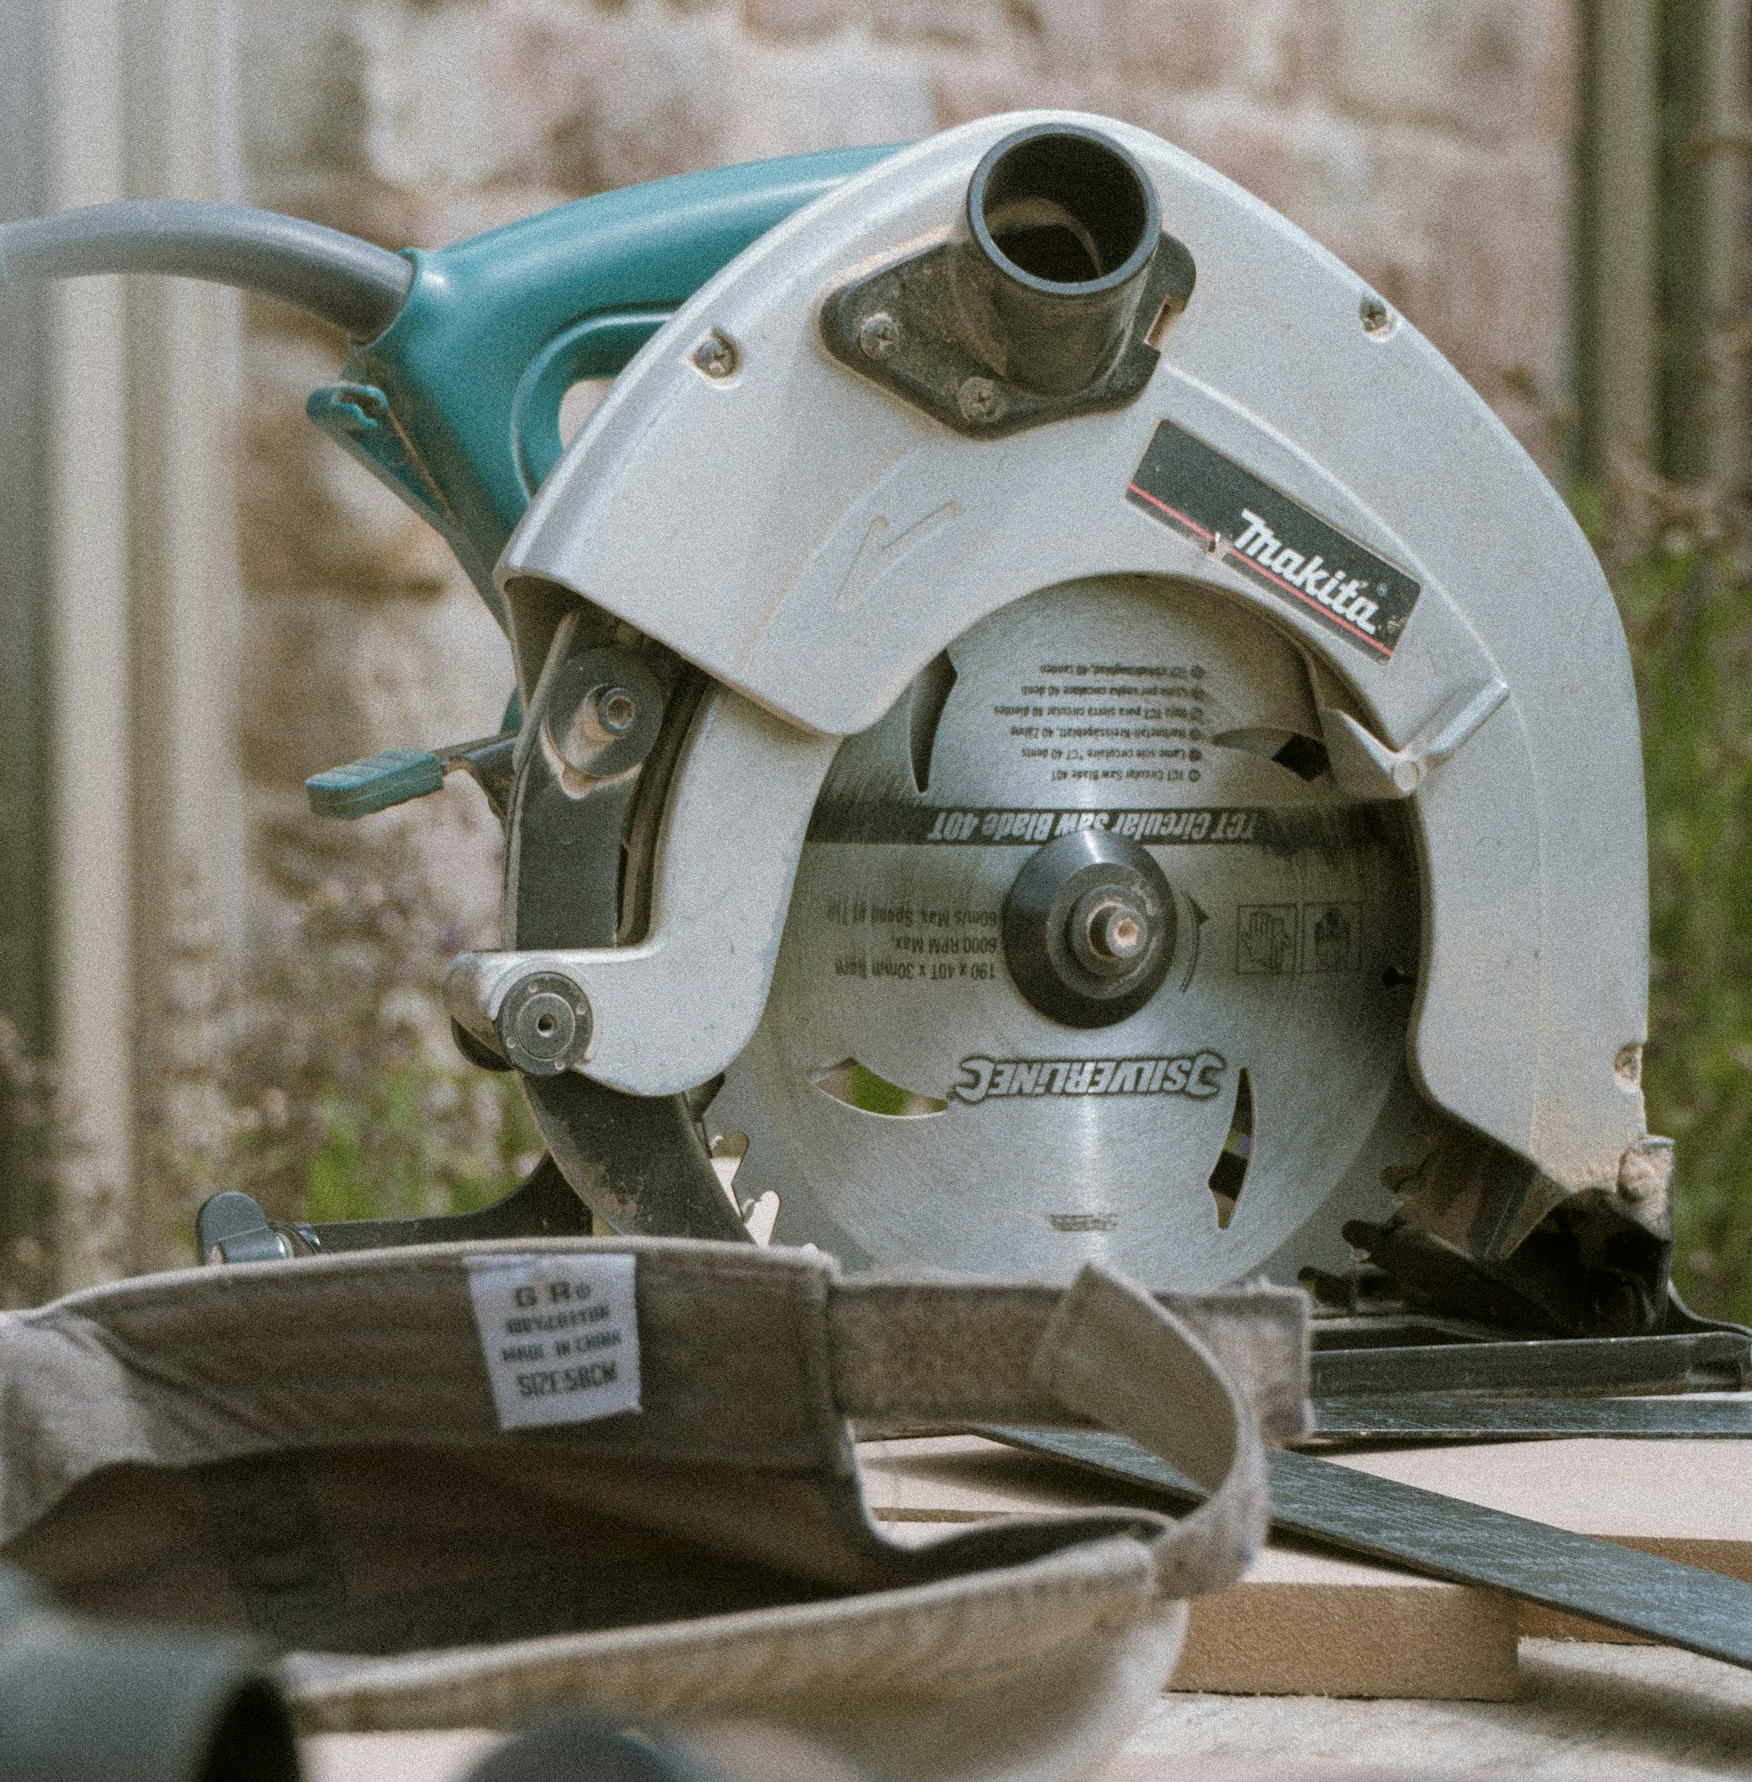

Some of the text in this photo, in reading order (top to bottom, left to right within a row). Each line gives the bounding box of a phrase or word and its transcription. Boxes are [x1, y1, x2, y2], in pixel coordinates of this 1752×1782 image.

[928, 812, 978, 840] 40T
[983, 813, 1054, 841] Blade
[1112, 812, 1211, 840] Circular
[1210, 812, 1257, 839] TCT
[929, 937, 959, 954] RPM
[963, 937, 997, 954] 6000
[931, 963, 954, 980] 40T
[971, 963, 995, 980] 190
